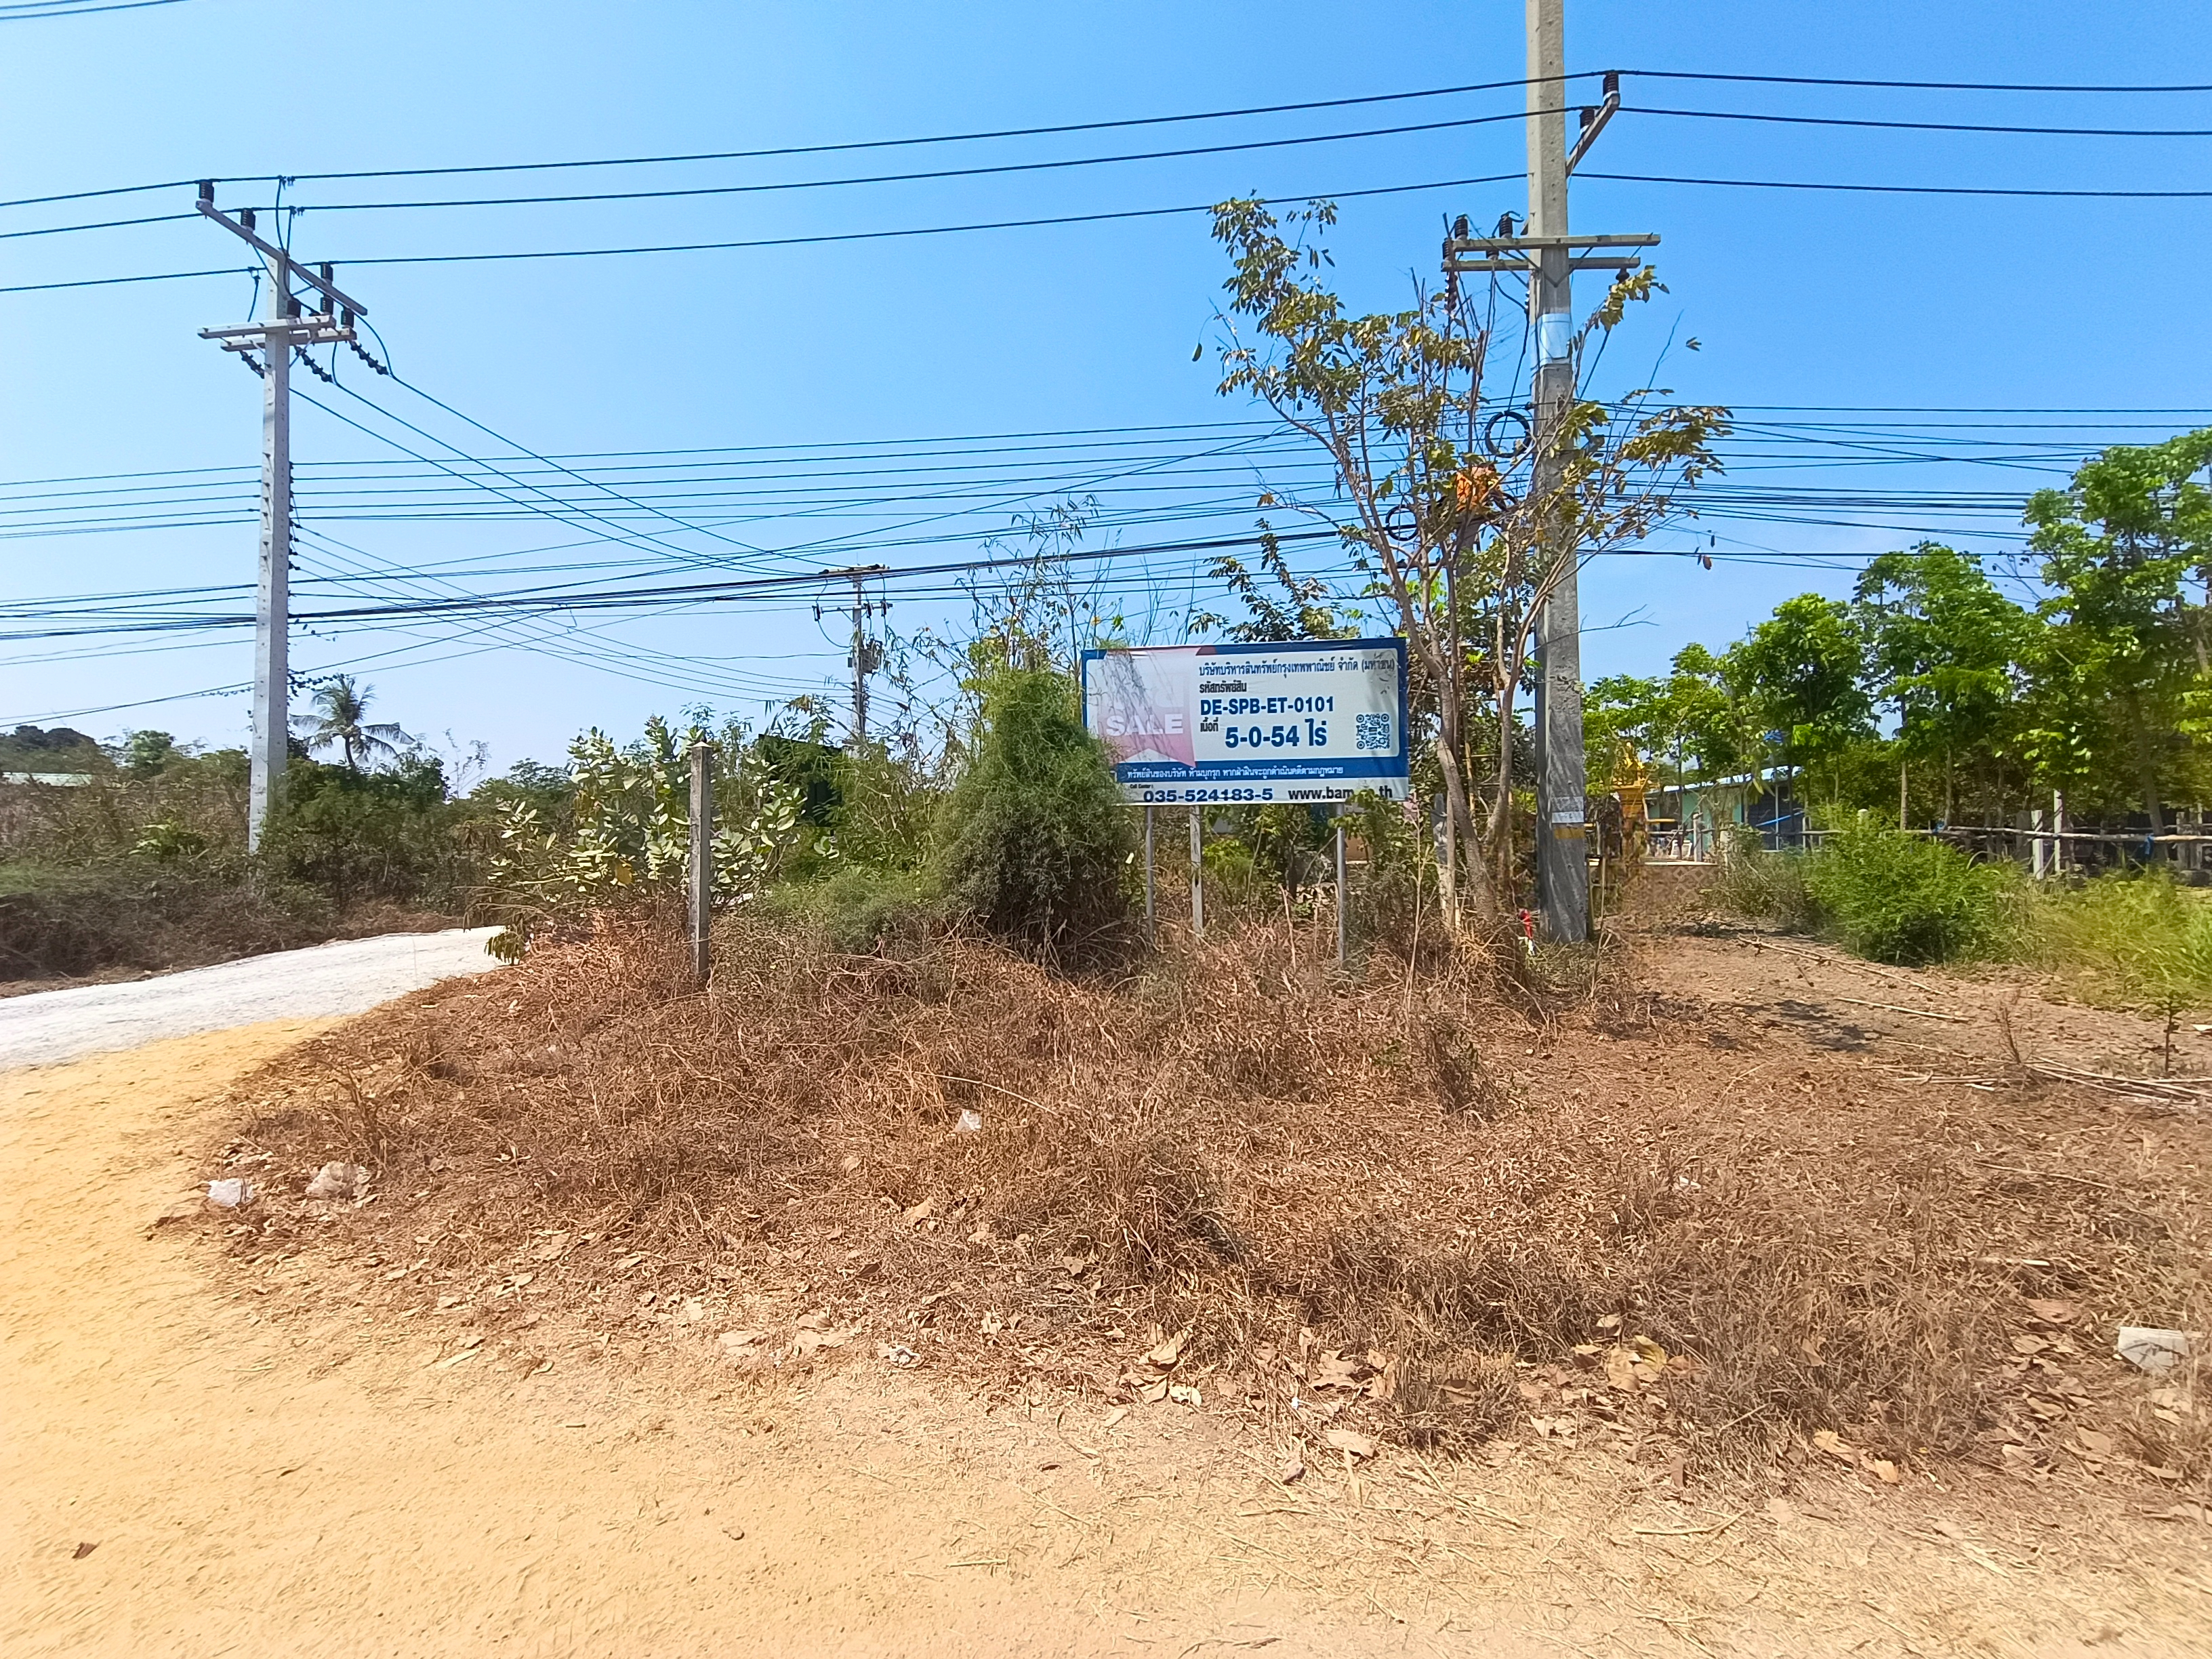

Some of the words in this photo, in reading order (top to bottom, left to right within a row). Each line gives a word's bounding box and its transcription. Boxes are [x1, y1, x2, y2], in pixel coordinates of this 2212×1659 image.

[1199, 656, 1335, 678] บริษัทบริหารสินทรัพย์กรุงเทพพาณิชย์
[1338, 657, 1358, 671] จำกัด
[1200, 680, 1247, 693] รหัสทรัพย์สิน
[1200, 696, 1334, 716] DE-SPB-ET-0101
[1106, 714, 1184, 737] SALE
[1200, 717, 1218, 732] เนื้อที่
[1225, 725, 1299, 748] 5-0-54
[1305, 718, 1327, 746] ไร่
[1143, 788, 1273, 803] 035-524183-5
